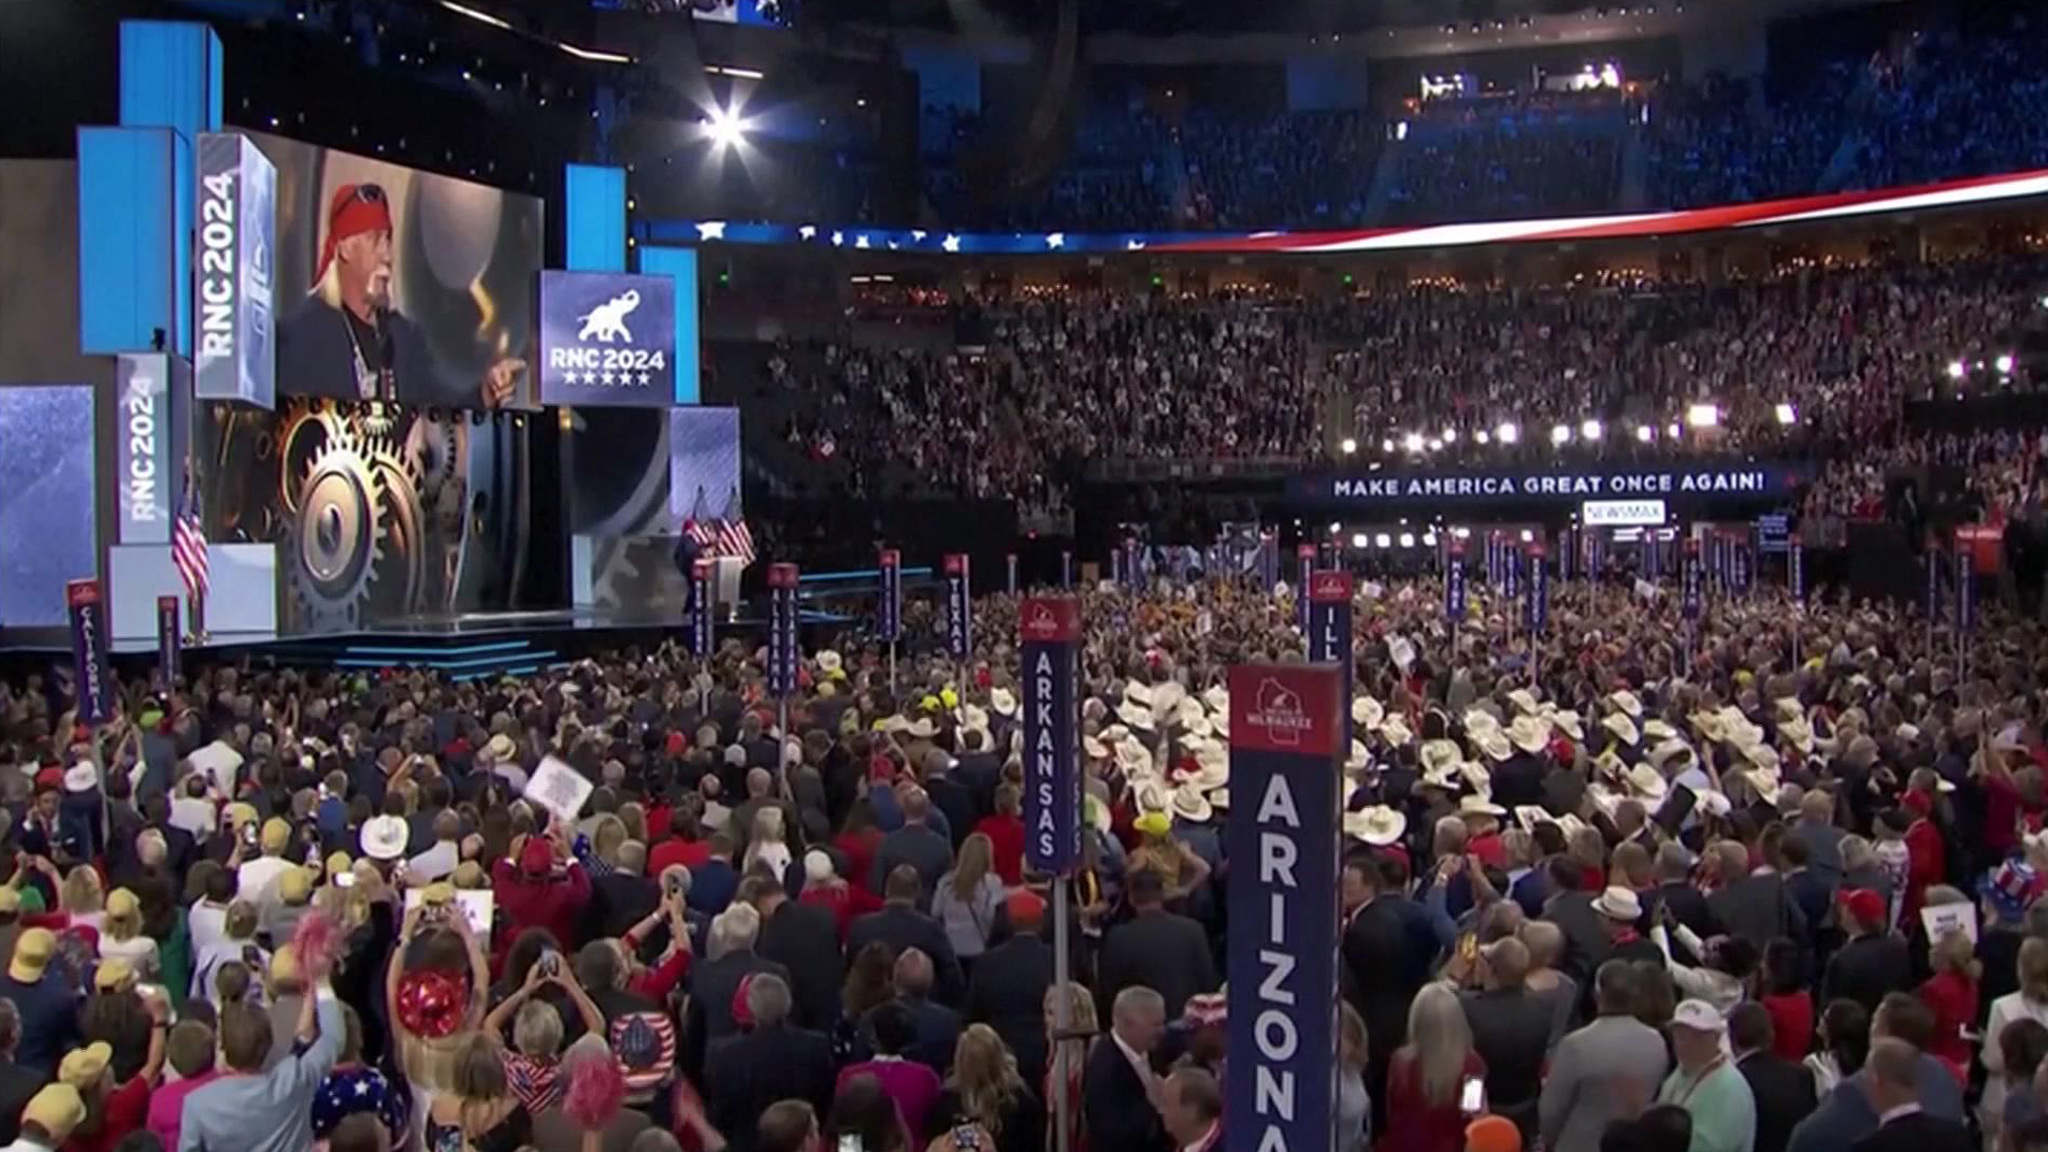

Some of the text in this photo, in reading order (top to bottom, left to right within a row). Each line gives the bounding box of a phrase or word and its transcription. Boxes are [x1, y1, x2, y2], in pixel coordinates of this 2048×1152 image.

[203, 173, 234, 358] RNC 2024
[551, 347, 664, 371] RNC 2024
[129, 378, 155, 521] RNC 2024
[1333, 472, 1765, 497] MAKE AMERICA GREAT ONCE AGAIN!
[81, 607, 103, 719] CALIFORNIA
[949, 578, 962, 654] TEXAS
[1035, 651, 1055, 857] ARKANSAS
